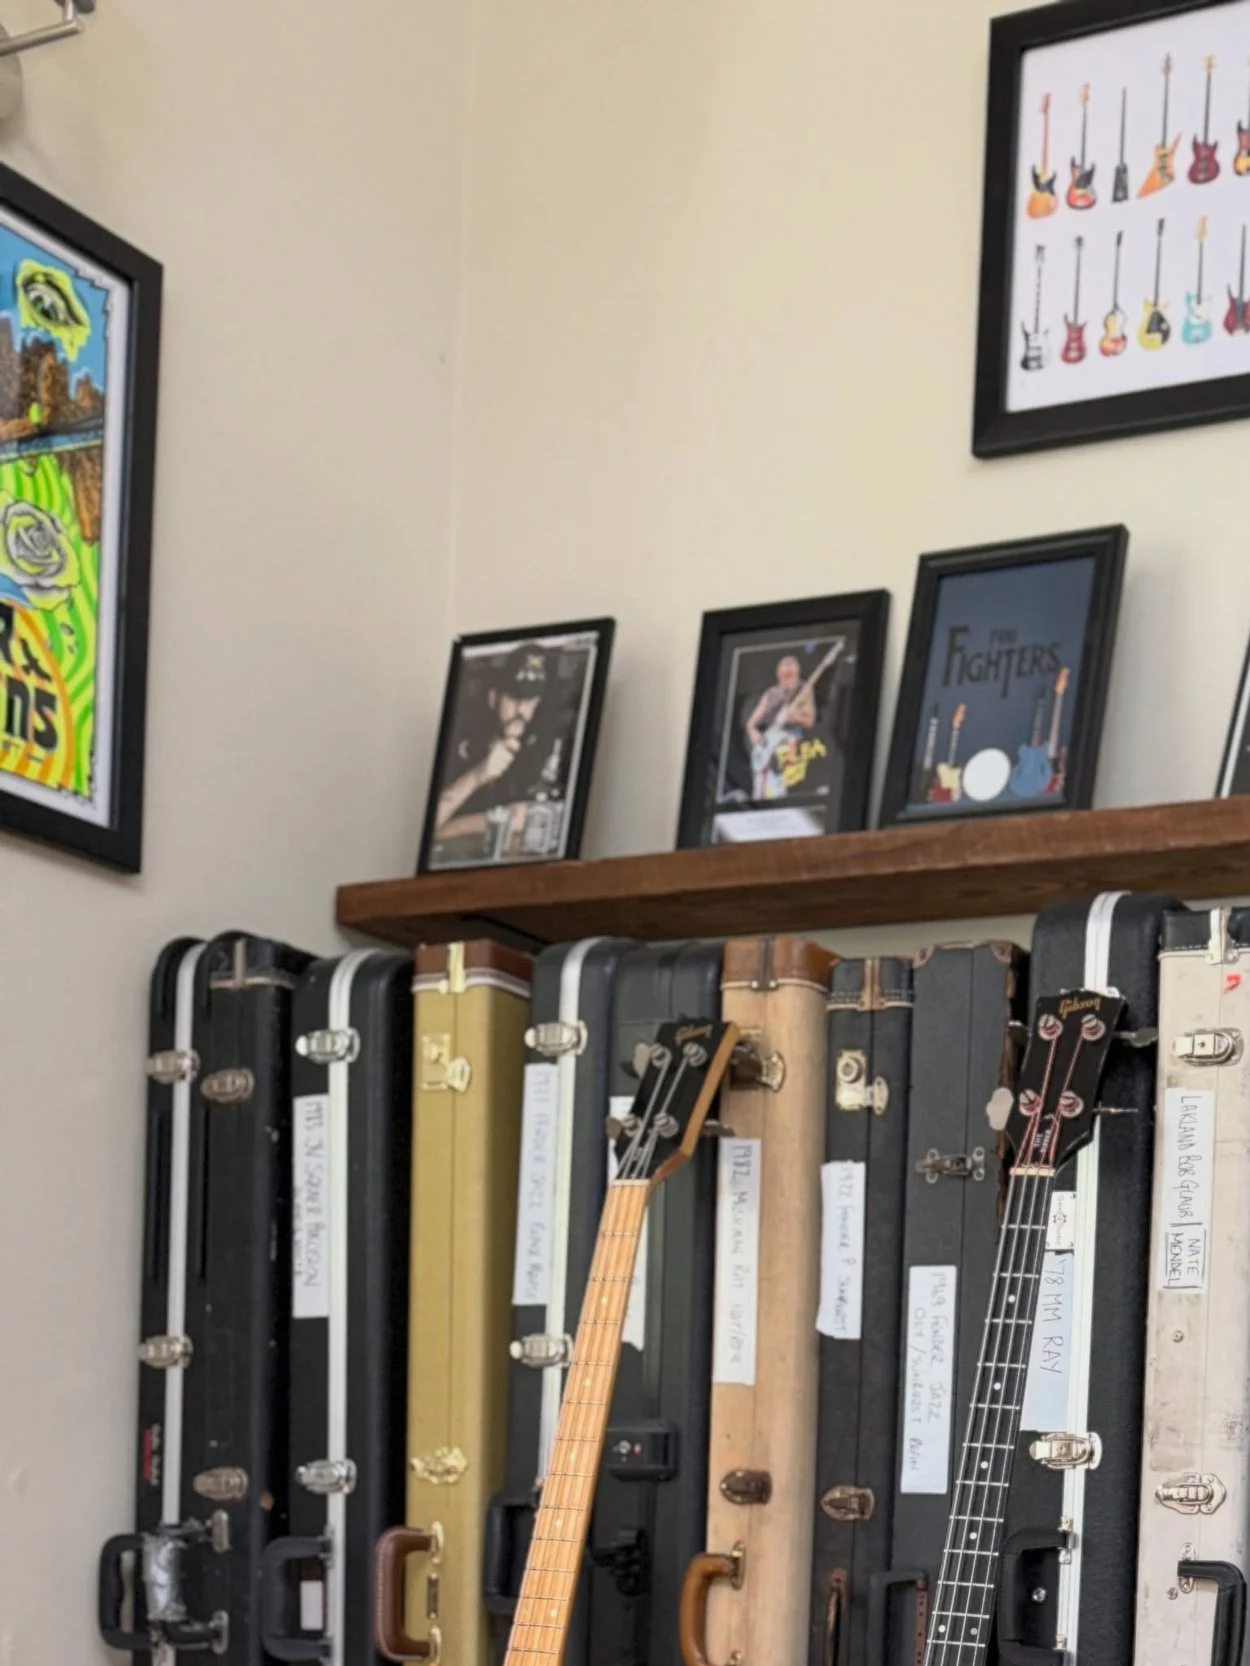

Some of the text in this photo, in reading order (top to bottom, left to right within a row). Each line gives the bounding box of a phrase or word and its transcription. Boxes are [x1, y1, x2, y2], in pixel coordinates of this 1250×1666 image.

[1059, 997, 1101, 1020] Gibson
[1176, 1095, 1203, 1151] LAKLAND
[1177, 1155, 1203, 1178] BOB
[1186, 1237, 1202, 1276] NATE
[1041, 1292, 1063, 1323] MM
[1040, 1336, 1065, 1374] RAY
